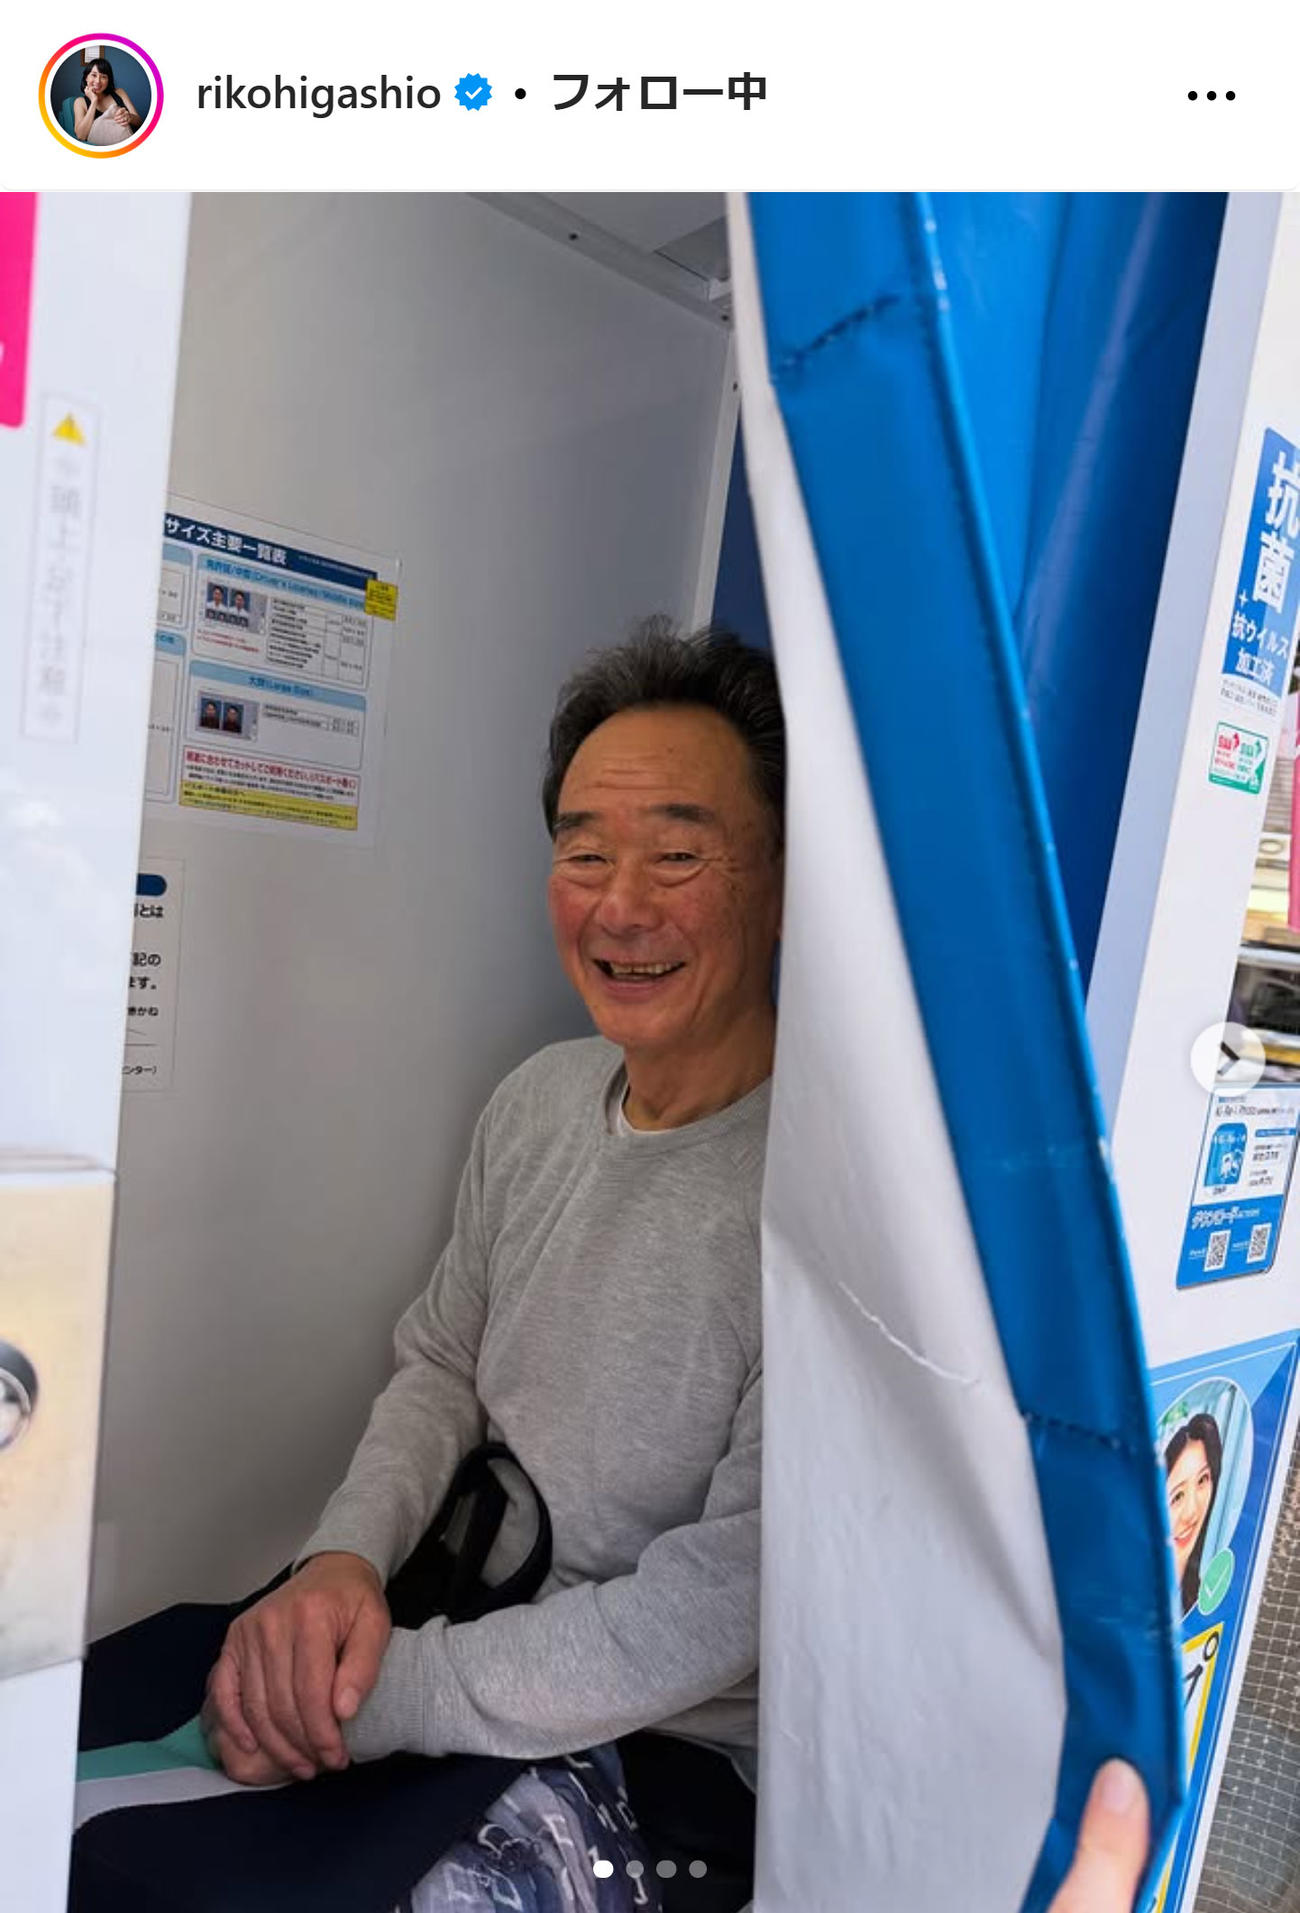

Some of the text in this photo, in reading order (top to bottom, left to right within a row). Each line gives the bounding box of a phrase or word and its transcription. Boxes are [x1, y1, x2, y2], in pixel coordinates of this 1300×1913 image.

[1253, 451, 1300, 613] 抗菌
[1231, 611, 1289, 660] 抗ウイルス
[1235, 648, 1275, 687] 加工済
